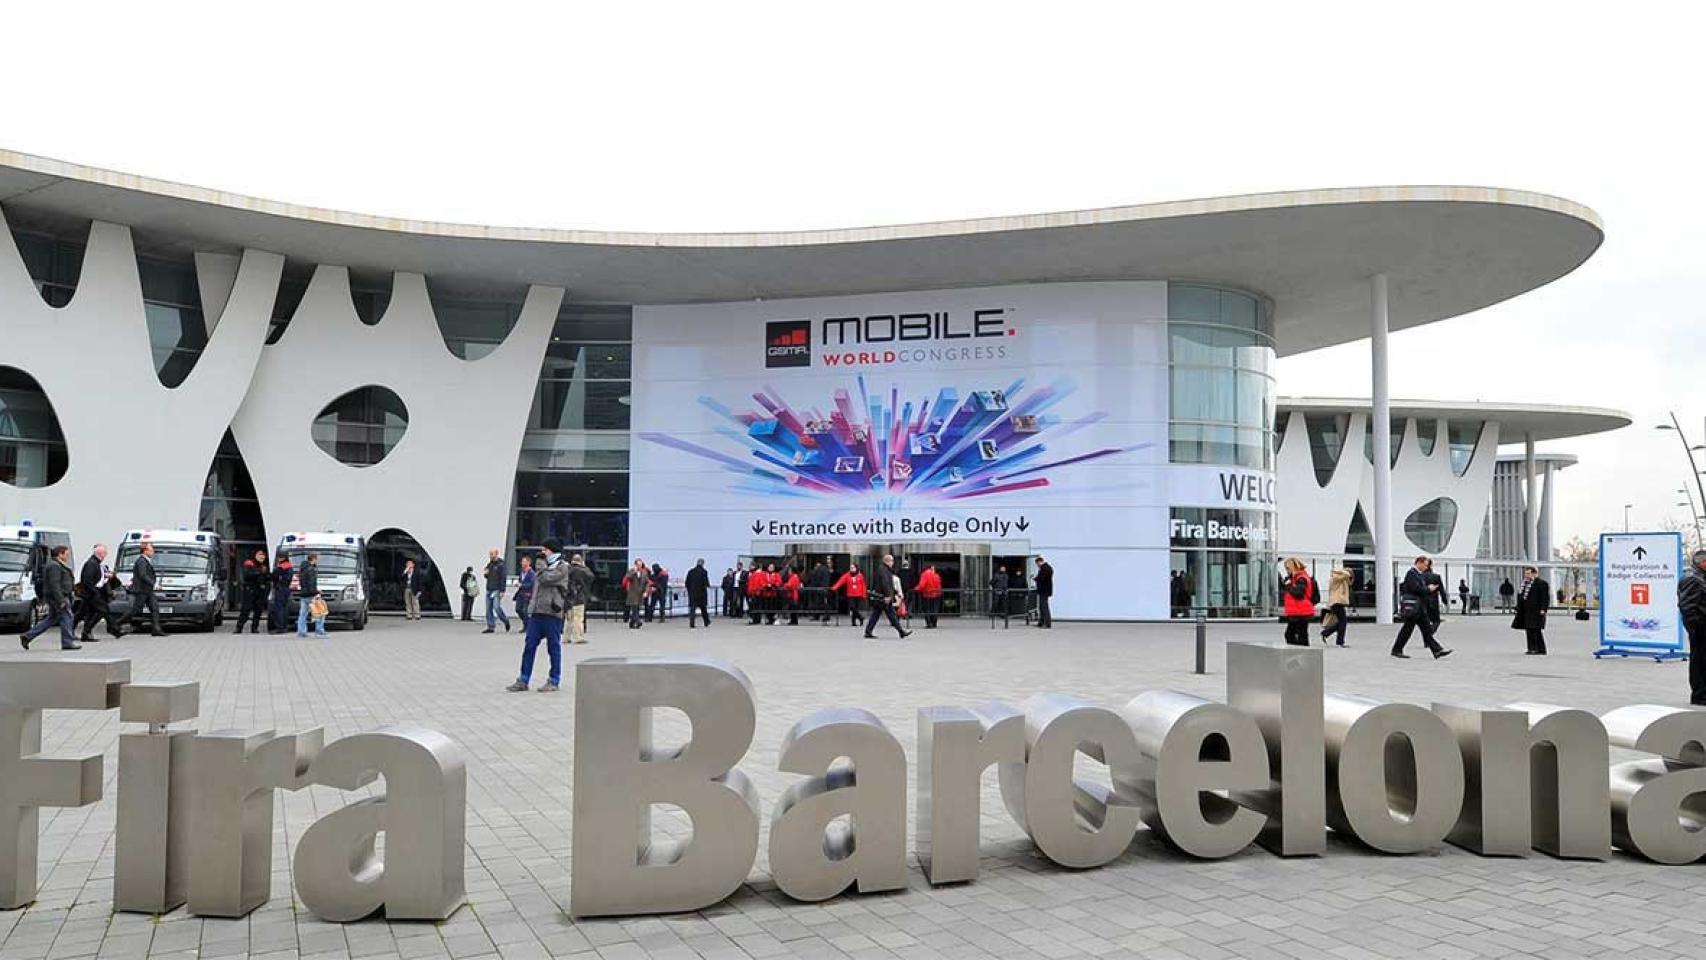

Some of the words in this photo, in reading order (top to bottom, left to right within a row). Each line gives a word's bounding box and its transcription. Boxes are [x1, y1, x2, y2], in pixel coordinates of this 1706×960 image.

[768, 519, 847, 536] Entrance
[852, 518, 894, 535] with
[900, 517, 960, 537] Badge
[965, 516, 1010, 537] Only
[1170, 519, 1204, 538] Fira
[1636, 591, 1644, 603] 1
